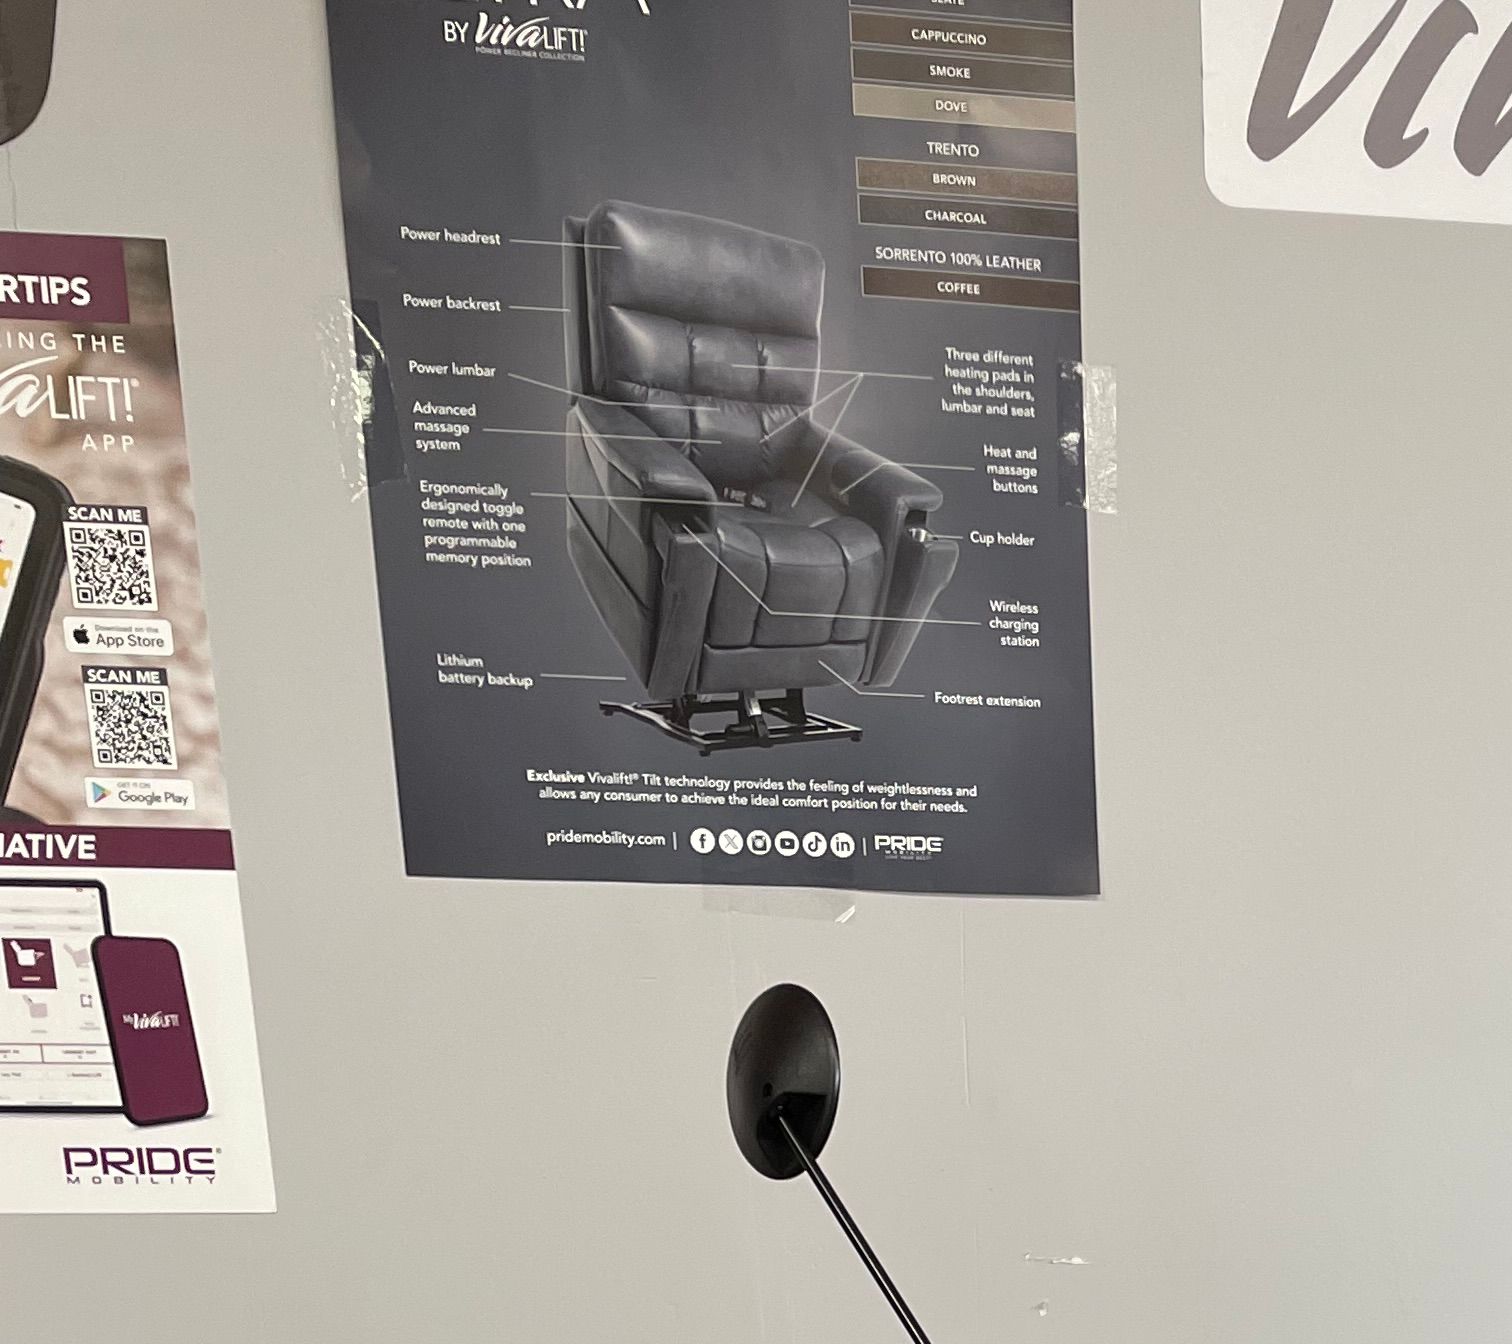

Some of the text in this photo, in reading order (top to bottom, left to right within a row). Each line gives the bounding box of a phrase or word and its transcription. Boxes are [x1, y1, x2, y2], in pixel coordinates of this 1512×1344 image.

[443, 20, 469, 43] BY
[911, 28, 987, 46] CAPPUCCINO
[539, 51, 586, 62] COLLECTION
[929, 65, 971, 79] SMOKE
[935, 100, 968, 113] DOVE
[926, 141, 980, 158] TRENTO
[932, 173, 976, 187] BROWN
[925, 210, 987, 225] CHARCOAL
[400, 226, 501, 245] Power headrest
[875, 246, 1042, 272] SORRENTO 100% LEATHER
[936, 281, 980, 295] COFFEE
[402, 294, 501, 312] Power backrest
[0, 331, 126, 353] ING THE
[945, 347, 1033, 366] Three different
[409, 360, 496, 377] Power lumbar
[945, 364, 1035, 384] heating pads in
[952, 383, 1035, 402] the shoulders,
[412, 401, 477, 417] Advanced
[941, 398, 1036, 418] lumbar and seat
[414, 421, 470, 437] massage
[82, 434, 135, 453] APP
[416, 438, 461, 452] system
[983, 444, 1038, 460] Heat and
[986, 464, 1038, 479] massage
[420, 480, 508, 499] Ergonomically
[993, 479, 1038, 494] buttons
[68, 506, 142, 523] SCAN ME
[421, 498, 524, 517] designed toggle
[423, 518, 526, 533] remote with one
[424, 534, 517, 550] programmable
[970, 531, 1036, 547] Cup holder
[426, 552, 532, 568] memory position
[989, 600, 1039, 614] Wireless
[989, 617, 1040, 634] charging
[96, 632, 164, 648] App Store
[1000, 635, 1040, 647] station
[436, 653, 484, 668] Lithium
[87, 669, 160, 684] SCAN ME
[438, 670, 534, 690] battery backup
[934, 691, 1042, 708] Footrest extension
[526, 769, 585, 783] Exclusive
[641, 773, 661, 787] Tilt
[664, 776, 731, 792] technology
[733, 777, 784, 793] provides
[787, 778, 806, 791] the
[809, 779, 849, 795] feeling
[852, 780, 865, 793] of
[867, 781, 953, 798] weightlessness
[955, 785, 978, 797] and
[118, 791, 189, 806] Google Play
[539, 787, 968, 813] allows any consumer to achieve the ideal comfort position for their needs.
[546, 829, 944, 852] pridemobility.com PRIDE
[63, 1147, 217, 1176] PRIDE
[67, 1176, 217, 1186] MOBILITY
